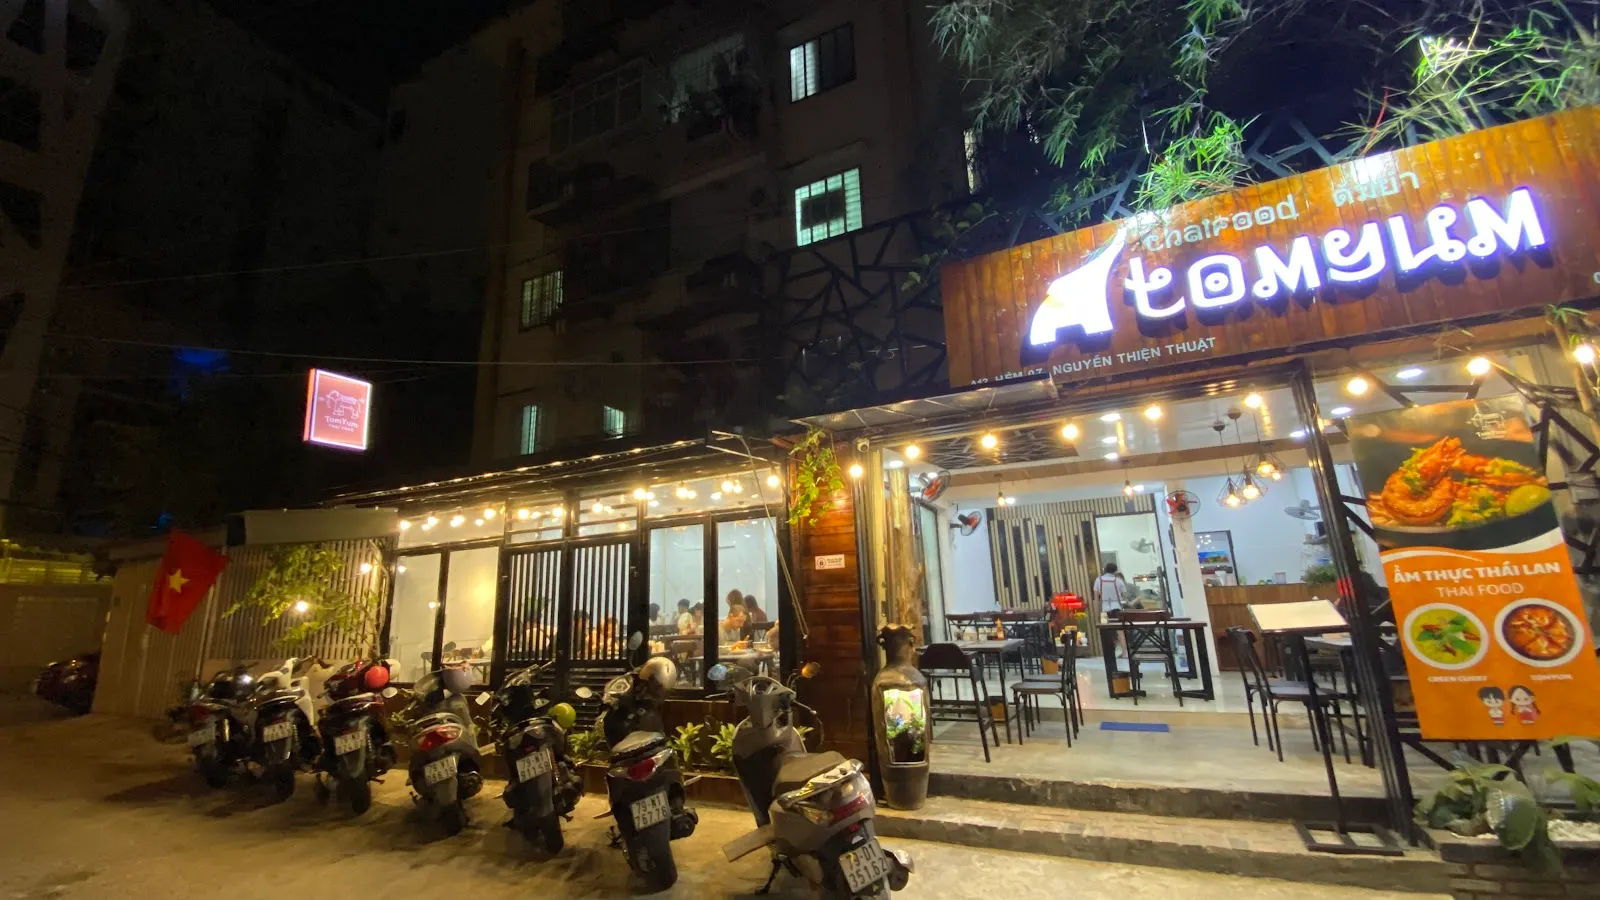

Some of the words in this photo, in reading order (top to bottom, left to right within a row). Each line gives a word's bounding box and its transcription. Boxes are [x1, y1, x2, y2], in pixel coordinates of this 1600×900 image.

[1117, 347, 1161, 365] THIỆN
[1165, 337, 1216, 356] THUẬT
[1423, 567, 1474, 584] THỰC
[1474, 561, 1520, 578] THÁI
[1523, 562, 1561, 576] LAN
[1436, 585, 1474, 598] THAI
[1478, 583, 1524, 597] FOOD
